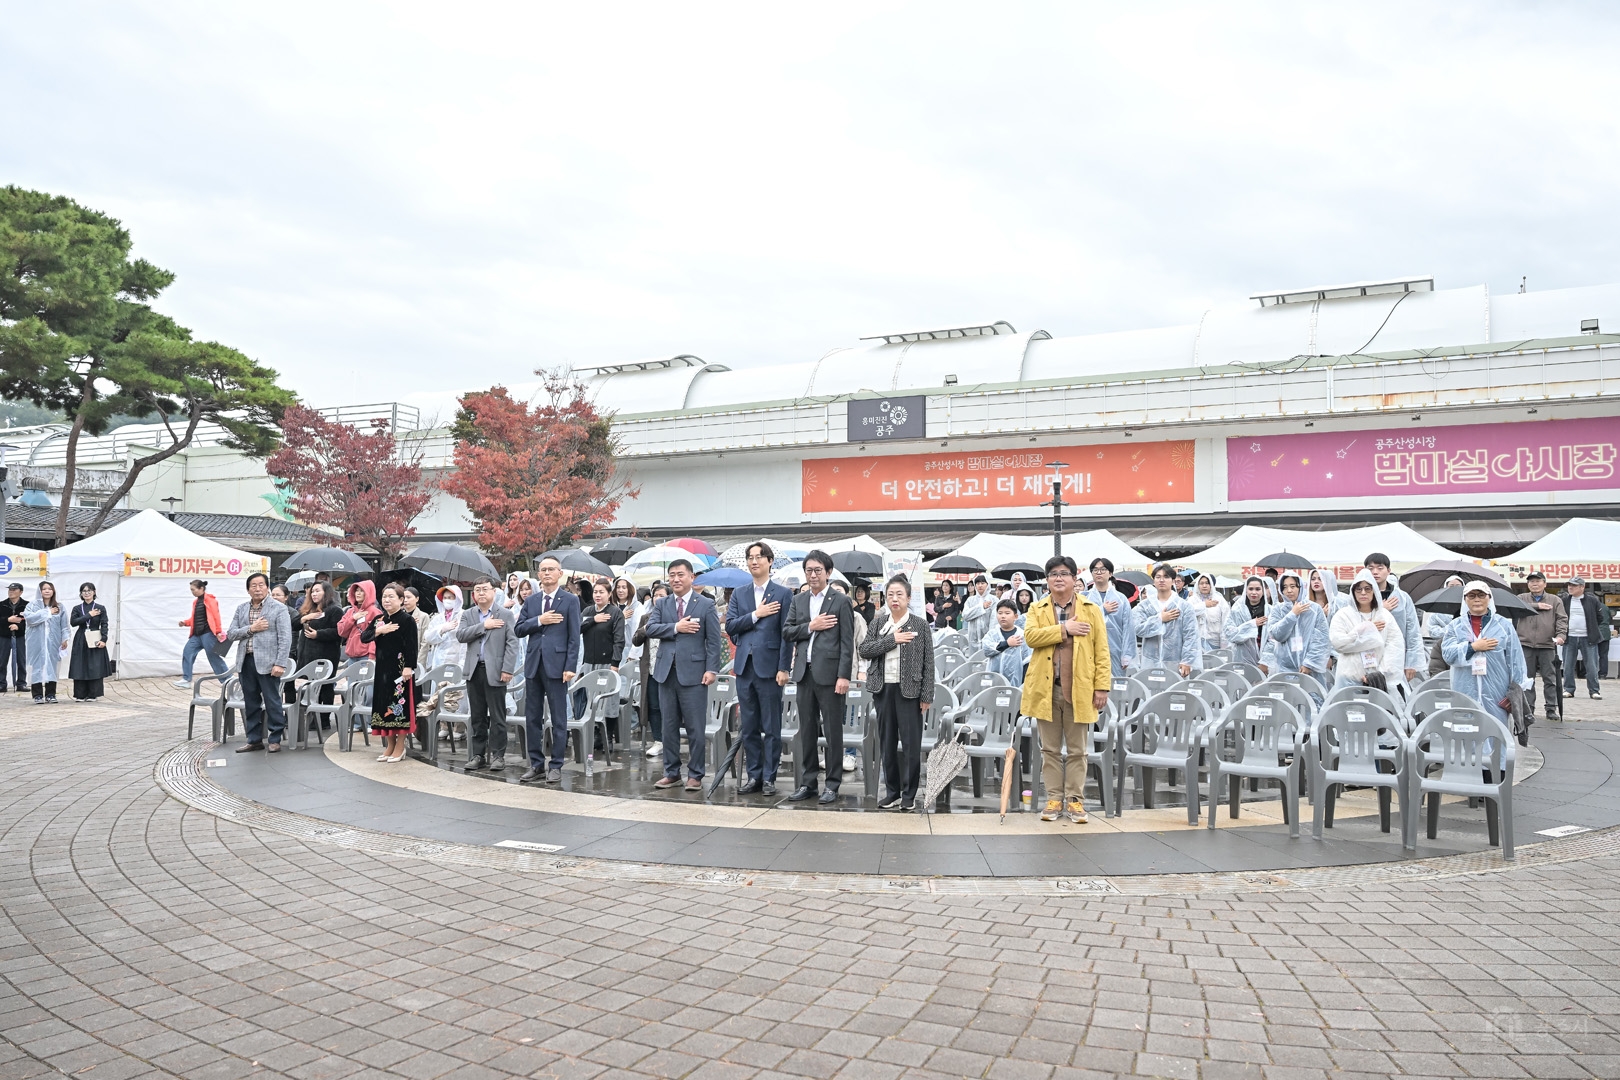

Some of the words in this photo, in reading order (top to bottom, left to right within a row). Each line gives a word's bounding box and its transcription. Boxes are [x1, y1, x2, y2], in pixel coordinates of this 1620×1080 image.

[875, 424, 895, 437] 공주
[1375, 436, 1437, 450] 공주산성시장
[924, 459, 966, 472] 공주산성시장
[967, 455, 1004, 471] 밤마실
[1374, 449, 1488, 487] 밤마실
[881, 479, 899, 500] 더
[905, 476, 989, 501] 안전하고!
[996, 474, 1015, 497] 더
[159, 557, 226, 574] 대기자부스
